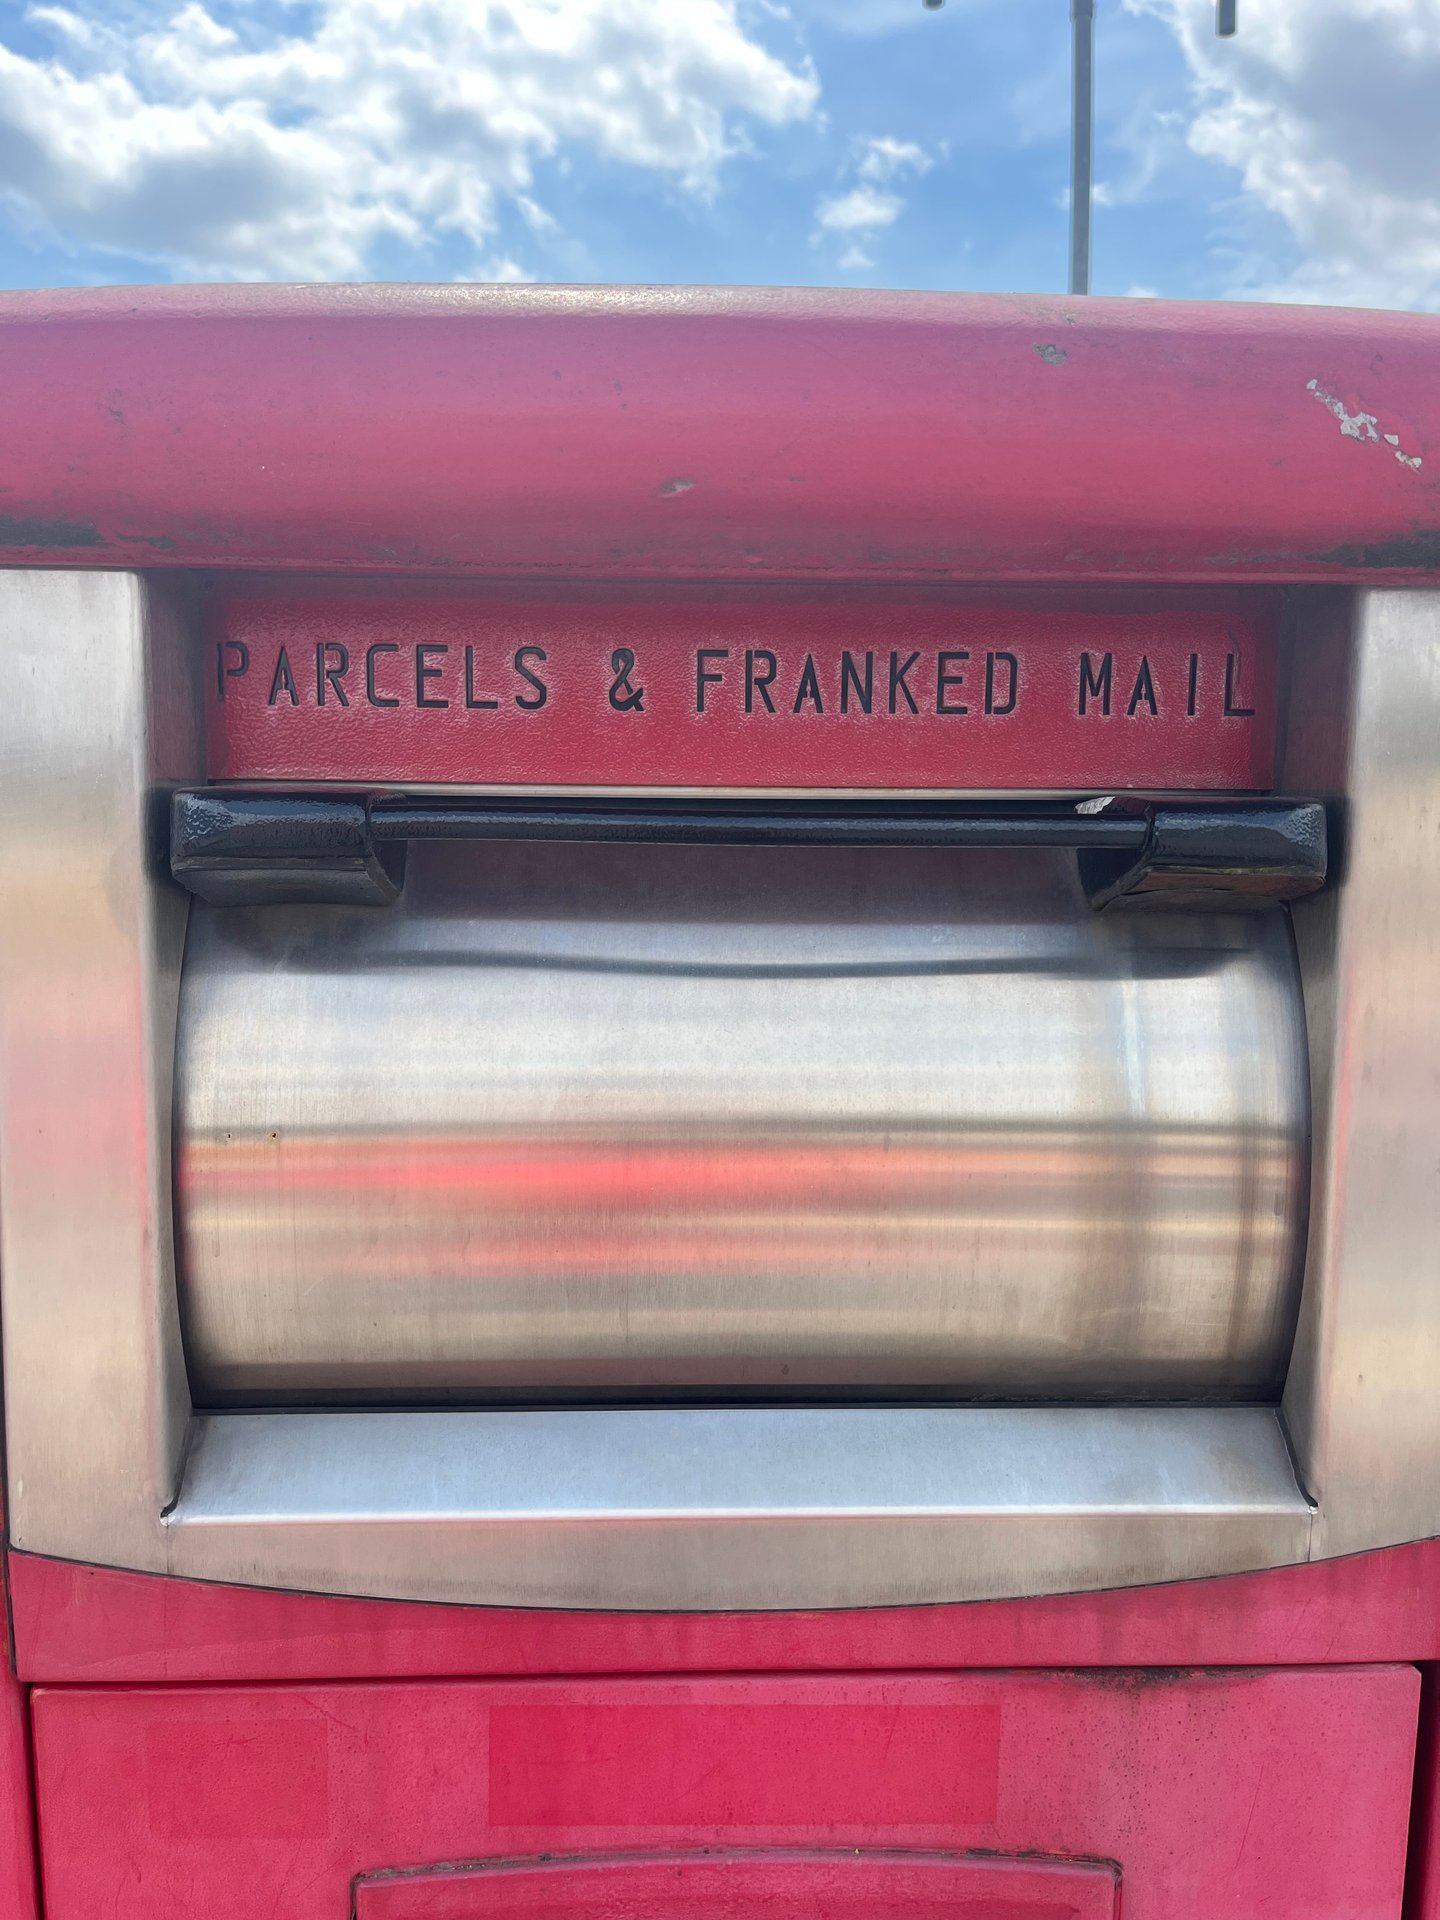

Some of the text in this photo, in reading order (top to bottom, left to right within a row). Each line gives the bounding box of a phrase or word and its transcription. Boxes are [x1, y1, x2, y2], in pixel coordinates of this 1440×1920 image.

[216, 641, 1256, 718] PARCELS & FRANKED MAIL
